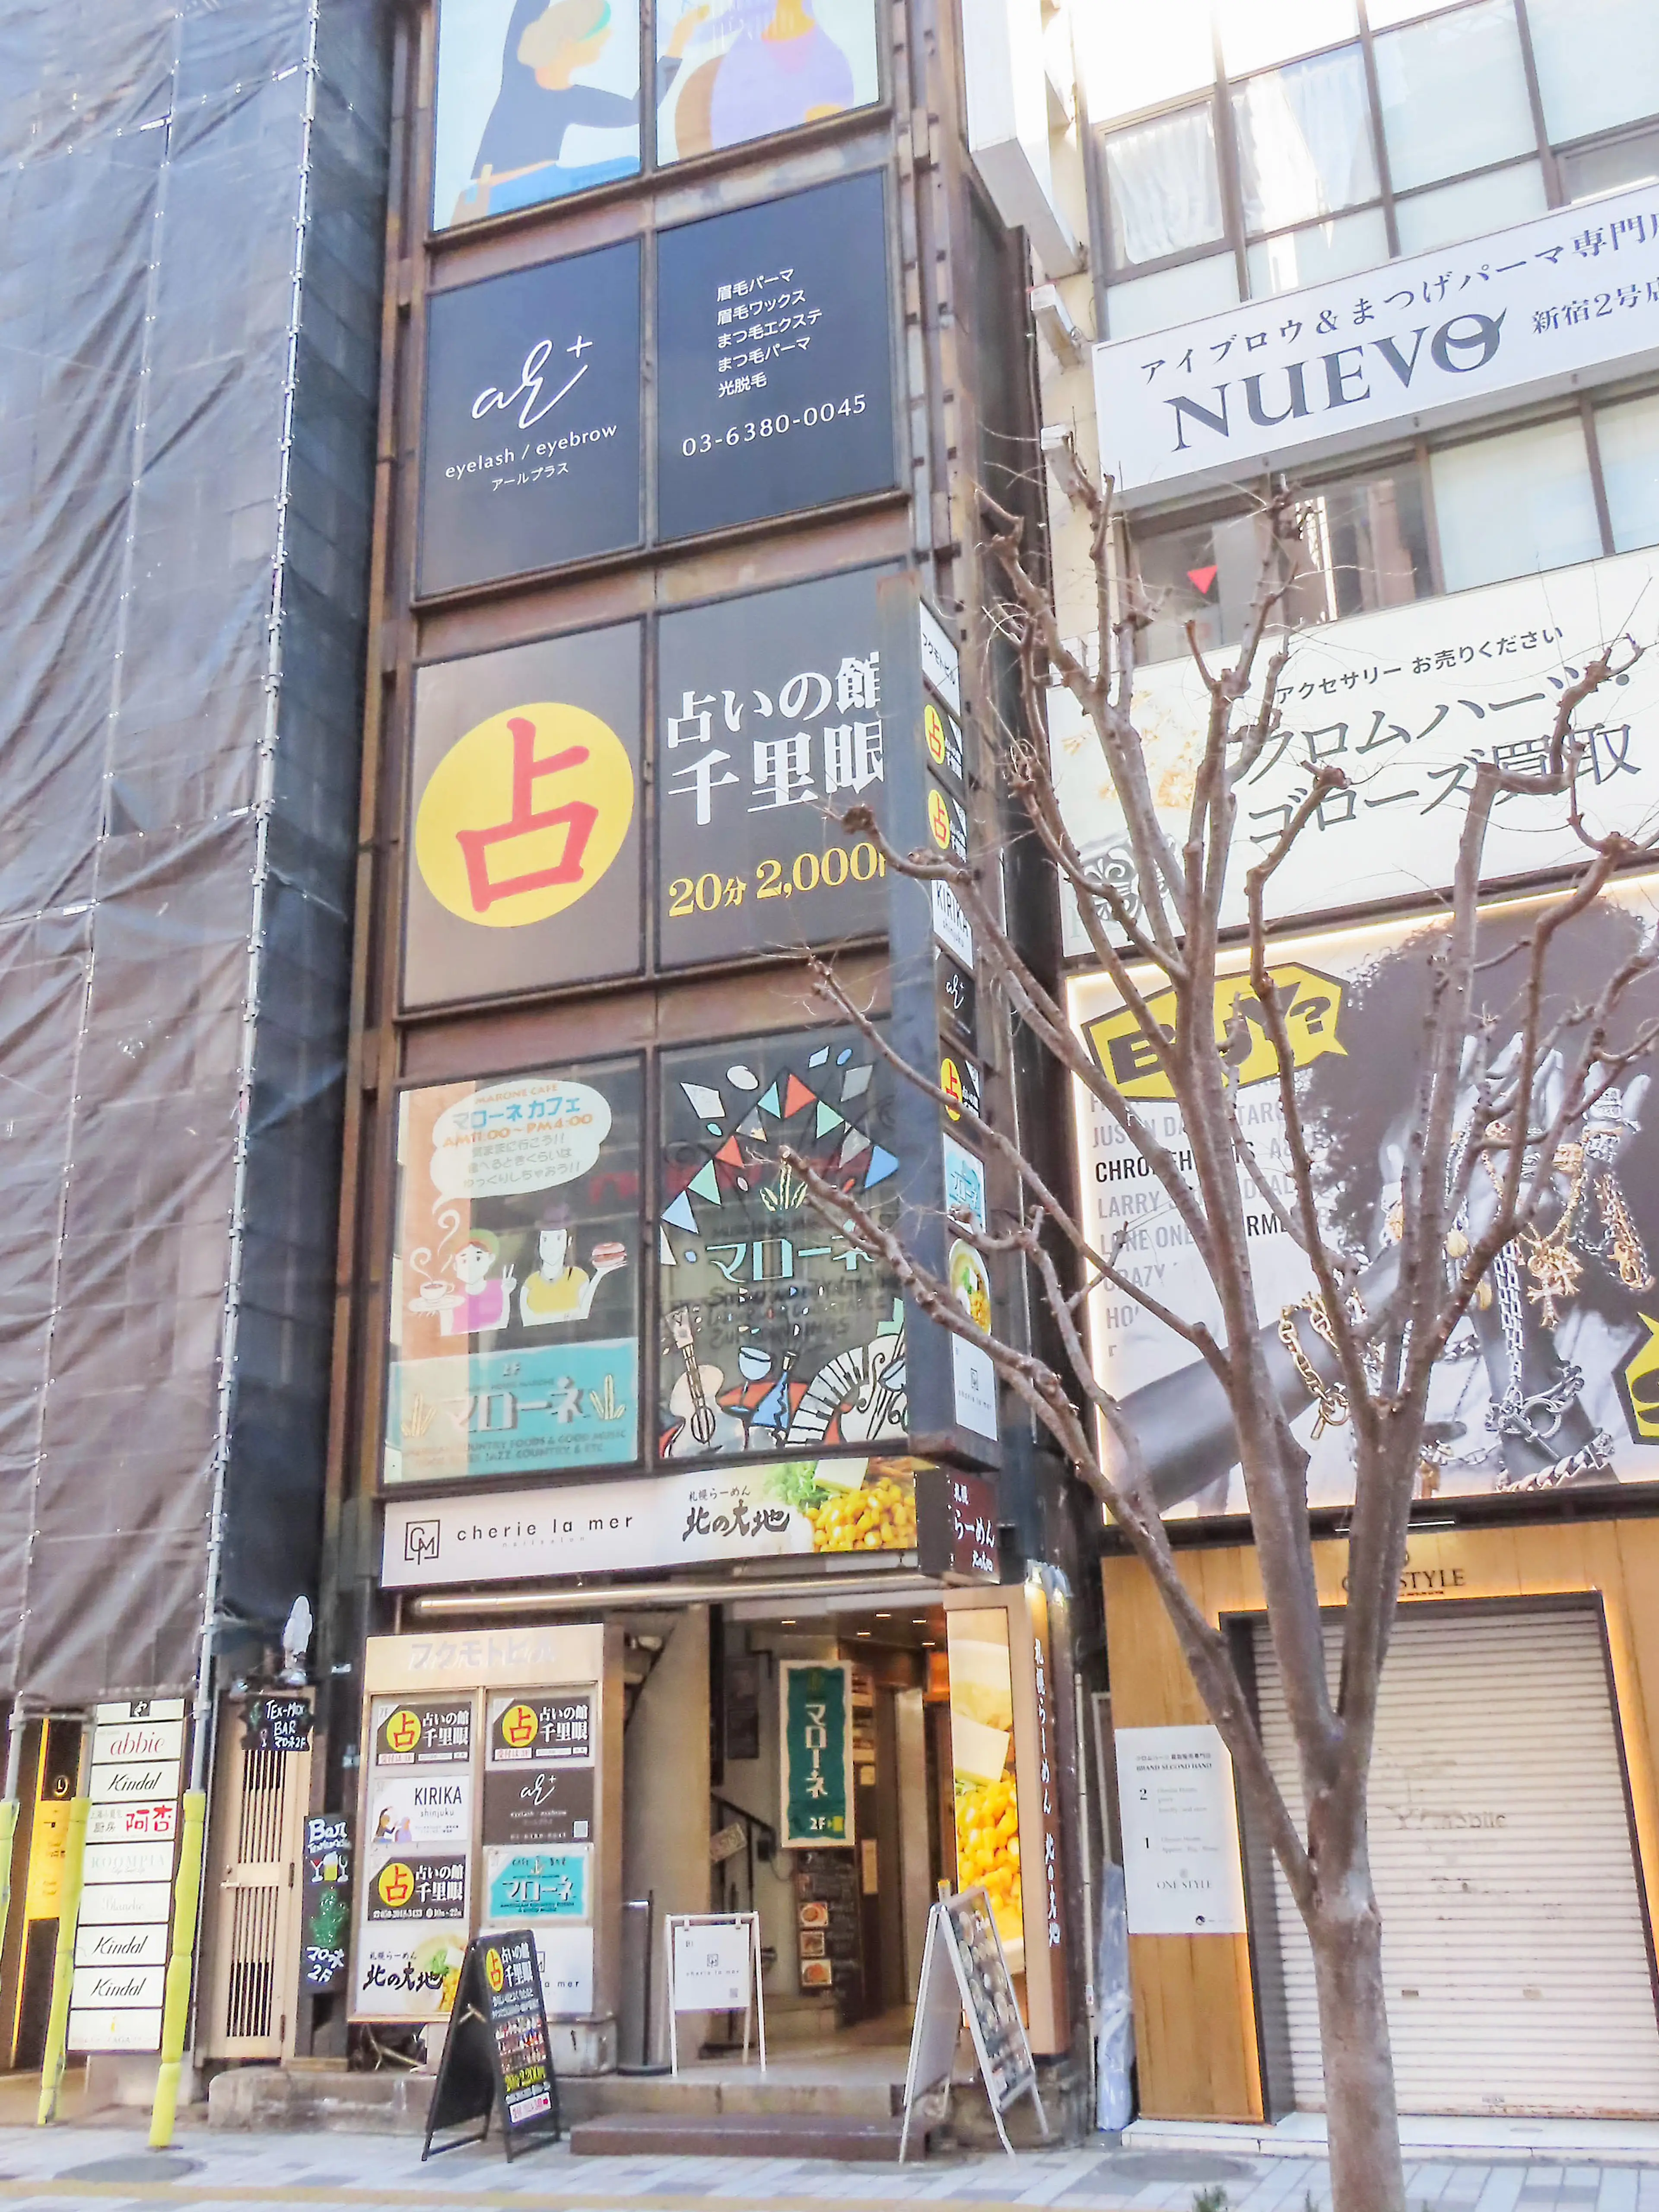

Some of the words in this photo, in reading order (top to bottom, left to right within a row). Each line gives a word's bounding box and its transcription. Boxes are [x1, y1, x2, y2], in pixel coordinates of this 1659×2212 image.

[717, 268, 794, 303] 眉毛パーマ
[717, 289, 807, 327] 眉毛ワックス
[717, 309, 823, 350] まつ毛エクステ
[717, 336, 810, 374] まつ毛パーマ
[718, 372, 768, 398] 光脱毛
[1164, 307, 1507, 452] NUEVO
[682, 394, 867, 458] 03-6380-0045
[445, 447, 515, 480] eyelash
[536, 426, 617, 458] eyebrow
[491, 463, 569, 492] アールプラス
[1278, 666, 1402, 704] アクセサリー
[1412, 626, 1564, 676] お売りください
[667, 720, 884, 826] 千里眼
[455, 716, 598, 913] 占
[668, 872, 746, 917] 20分
[756, 842, 887, 900] 2,000
[937, 881, 969, 937] KIRIKA
[528, 1096, 581, 1119] カフェ
[1098, 1191, 1160, 1219] LARRY
[457, 1522, 536, 1541] cherie
[553, 1519, 572, 1533] la
[588, 1514, 632, 1530] mer
[682, 1499, 789, 1542] 北の大地
[954, 1509, 995, 1548] らーめん
[423, 1710, 469, 1727] 占いの館
[510, 1707, 531, 1742] 占
[540, 1705, 588, 1721] 占いの館
[110, 1732, 165, 1755] abbie
[274, 1722, 296, 1737] BAR
[393, 1713, 414, 1748] 占
[423, 1727, 468, 1748] 千里眼
[540, 1721, 588, 1743] 千里眼
[805, 1703, 828, 1799] マローネ
[108, 1772, 163, 1791] Kindal
[414, 1786, 462, 1805] KIRIKA
[1140, 1788, 1147, 1800] 2
[420, 1808, 454, 1818] shinjuku
[810, 1817, 826, 1831] 2F
[1145, 1837, 1149, 1849] 1
[385, 1865, 407, 1901] 占
[416, 1865, 463, 1880] 占いの館
[416, 1881, 463, 1902] 千里眼
[92, 1936, 149, 1955] Kindal
[90, 1977, 147, 1996] Kindal
[363, 1961, 444, 1992] 北の大地
